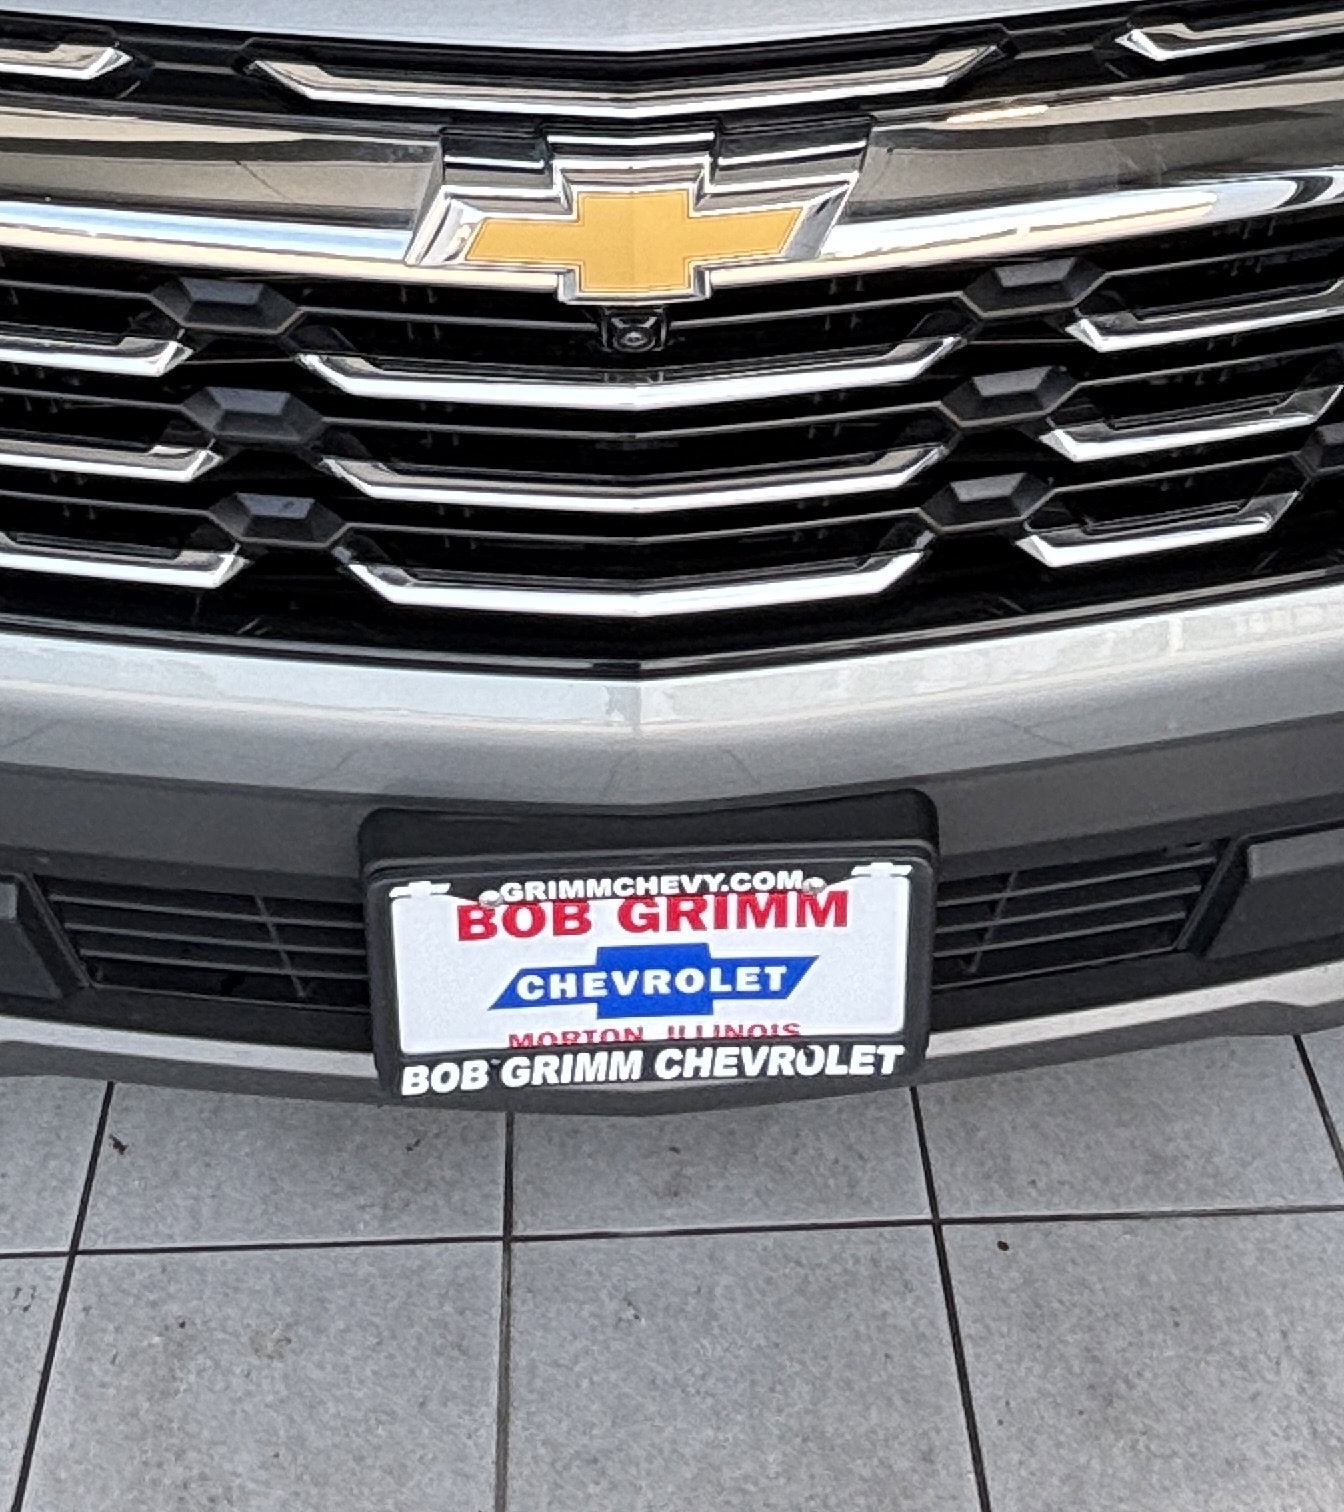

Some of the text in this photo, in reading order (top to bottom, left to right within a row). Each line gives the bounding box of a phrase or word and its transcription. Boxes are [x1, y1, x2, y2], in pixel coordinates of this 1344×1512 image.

[500, 870, 804, 902] GRIMMCHEVY.COM
[457, 890, 848, 941] BOB GRIMM
[516, 965, 788, 1001] CHEVROLET
[509, 1027, 644, 1048] MORTON
[402, 1043, 906, 1095] BOB GRIMM CHEVROLET
